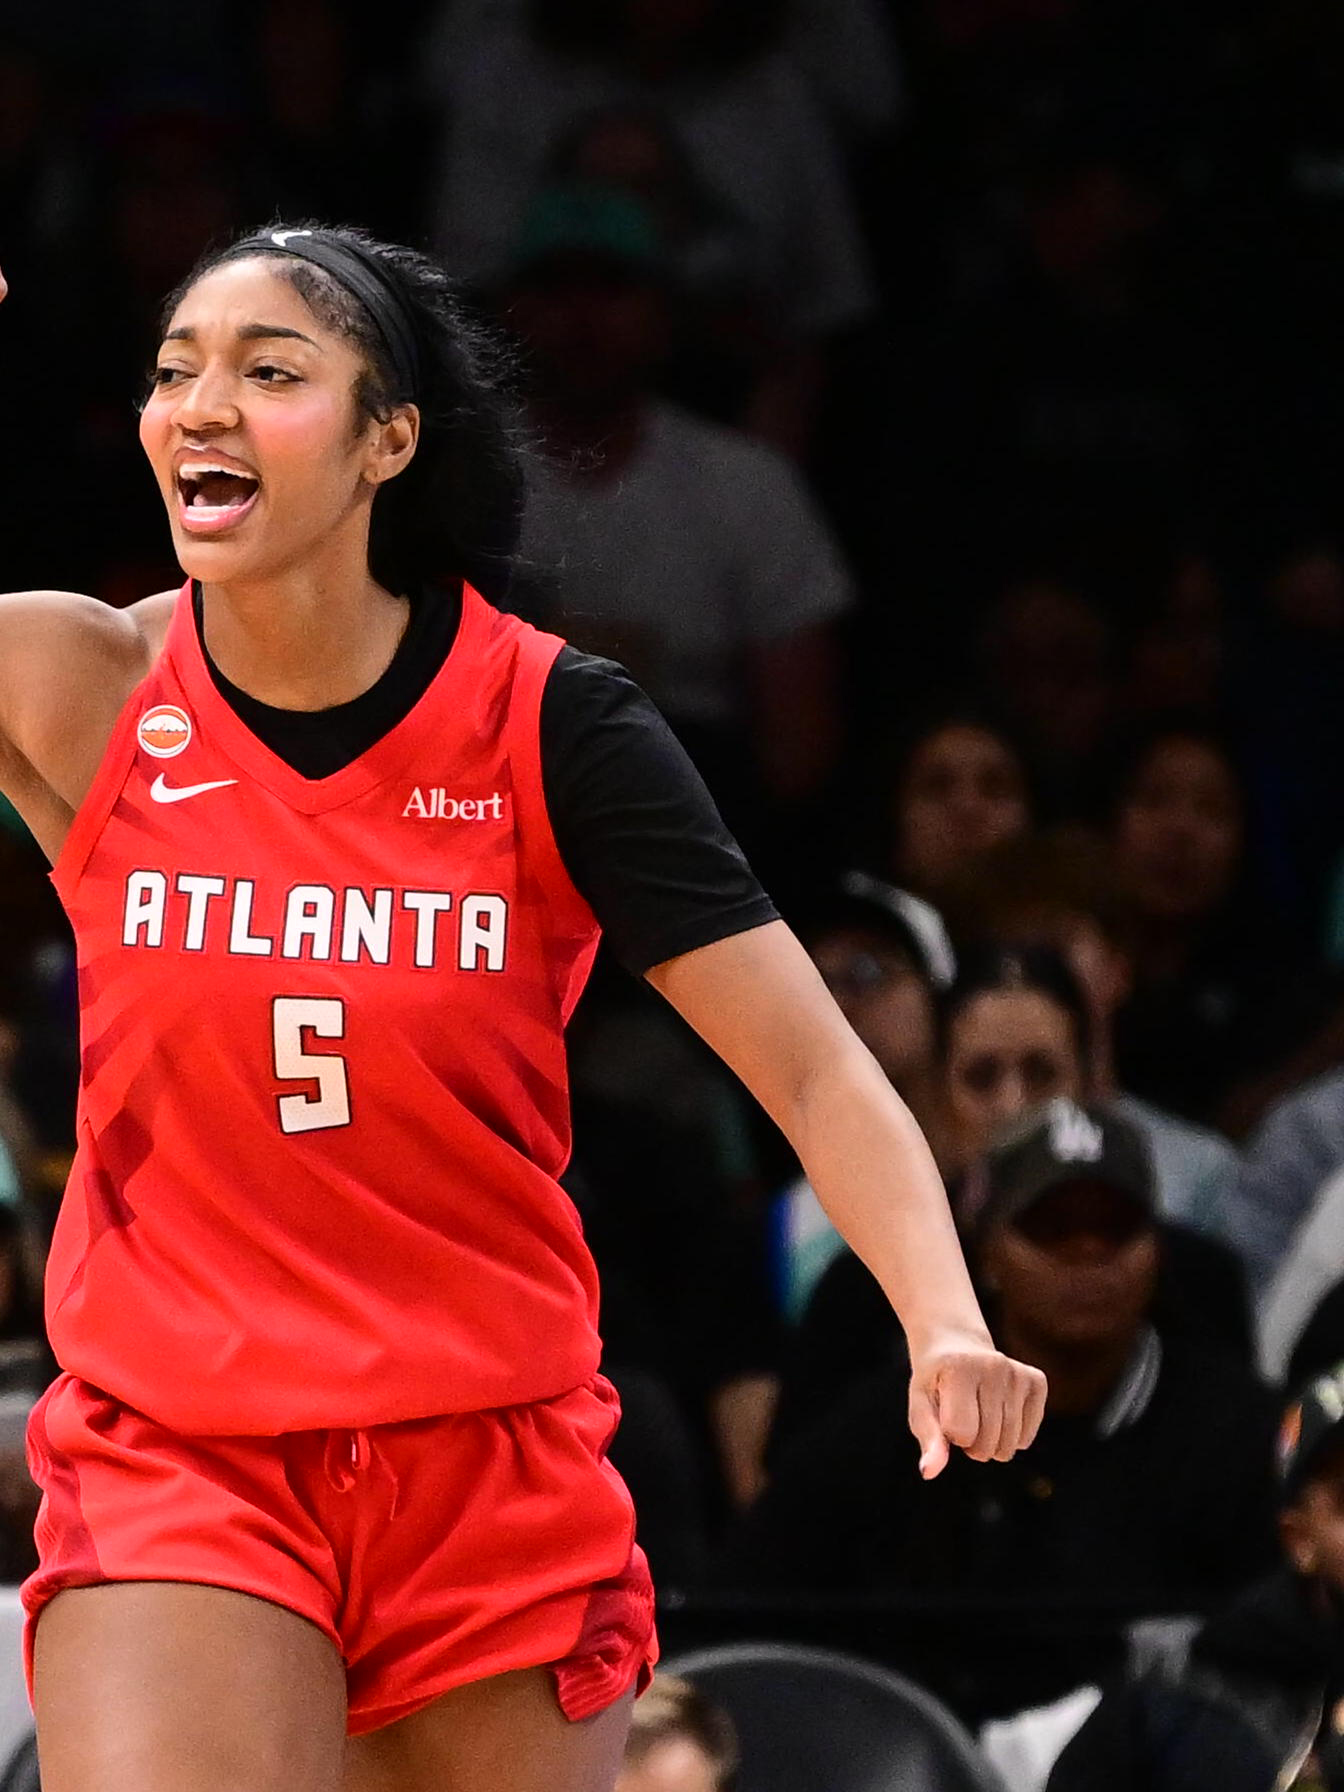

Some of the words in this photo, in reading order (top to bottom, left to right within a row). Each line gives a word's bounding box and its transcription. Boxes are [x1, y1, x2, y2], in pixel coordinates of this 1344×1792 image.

[401, 786, 503, 820] Albert
[122, 869, 509, 973] ATLANTA
[272, 996, 352, 1133] 5
